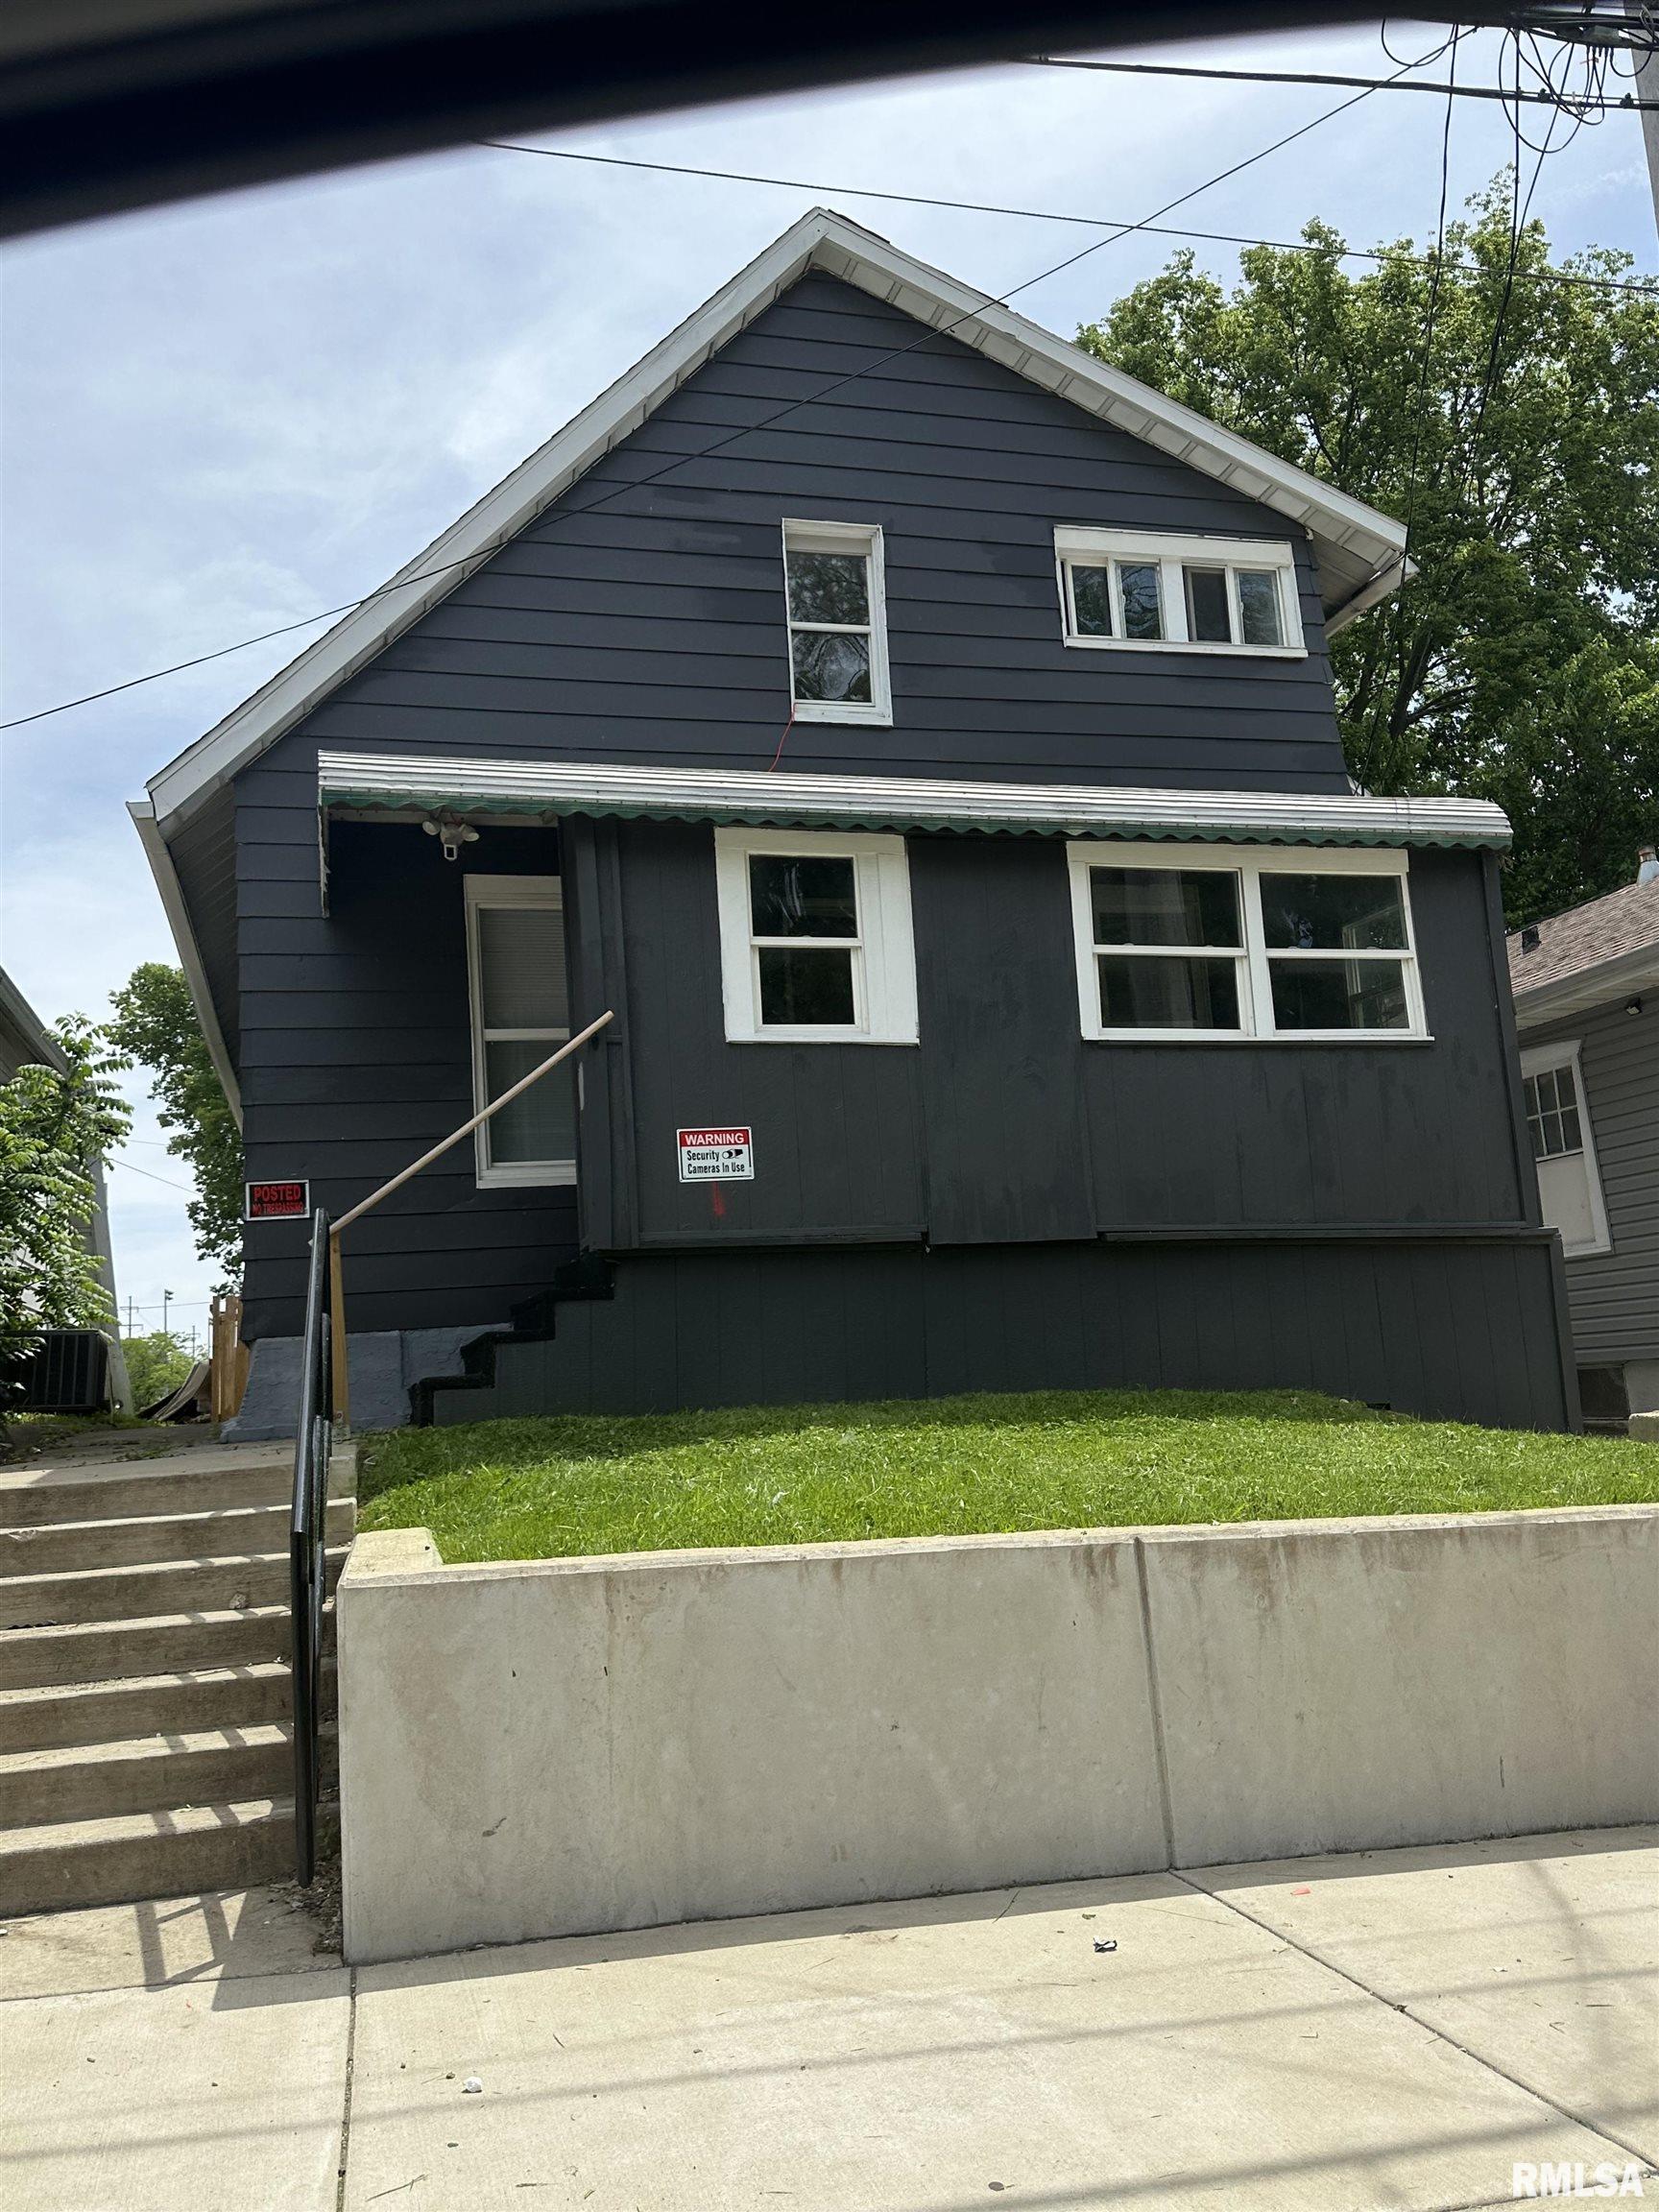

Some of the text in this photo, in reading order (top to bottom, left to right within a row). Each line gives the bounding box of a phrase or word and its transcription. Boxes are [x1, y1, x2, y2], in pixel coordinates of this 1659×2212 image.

[685, 1133, 745, 1145] WARNING
[686, 1150, 720, 1162] Security
[687, 1162, 745, 1174] Cameras In Use
[253, 1185, 301, 1202] POSTED
